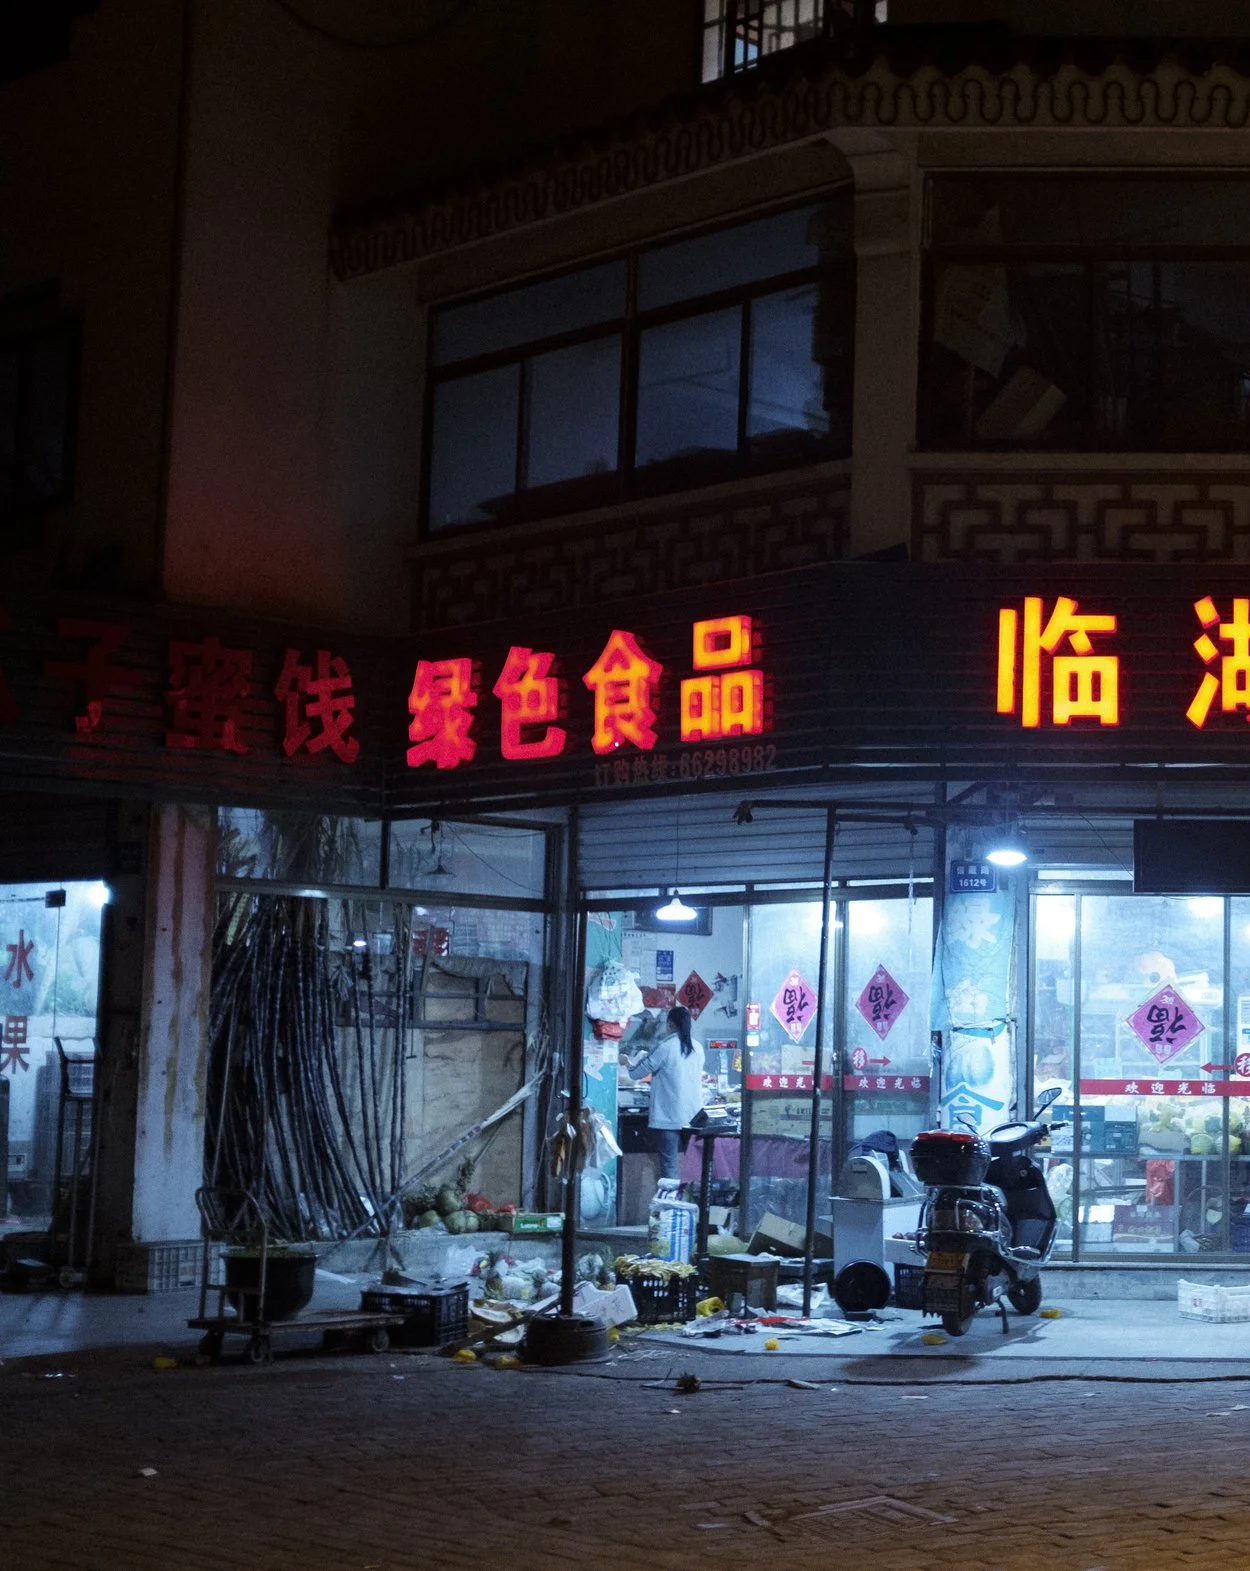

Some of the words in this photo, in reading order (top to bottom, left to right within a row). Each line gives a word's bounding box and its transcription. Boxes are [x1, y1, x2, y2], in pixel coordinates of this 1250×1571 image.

[406, 614, 768, 769] 绿色食品
[0, 929, 34, 1074] 水果
[1146, 1004, 1187, 1044] 福
[763, 1076, 815, 1088] 欢迎光
[859, 1077, 922, 1089] 欢迎光临
[1124, 1082, 1217, 1095] 欢迎光临
